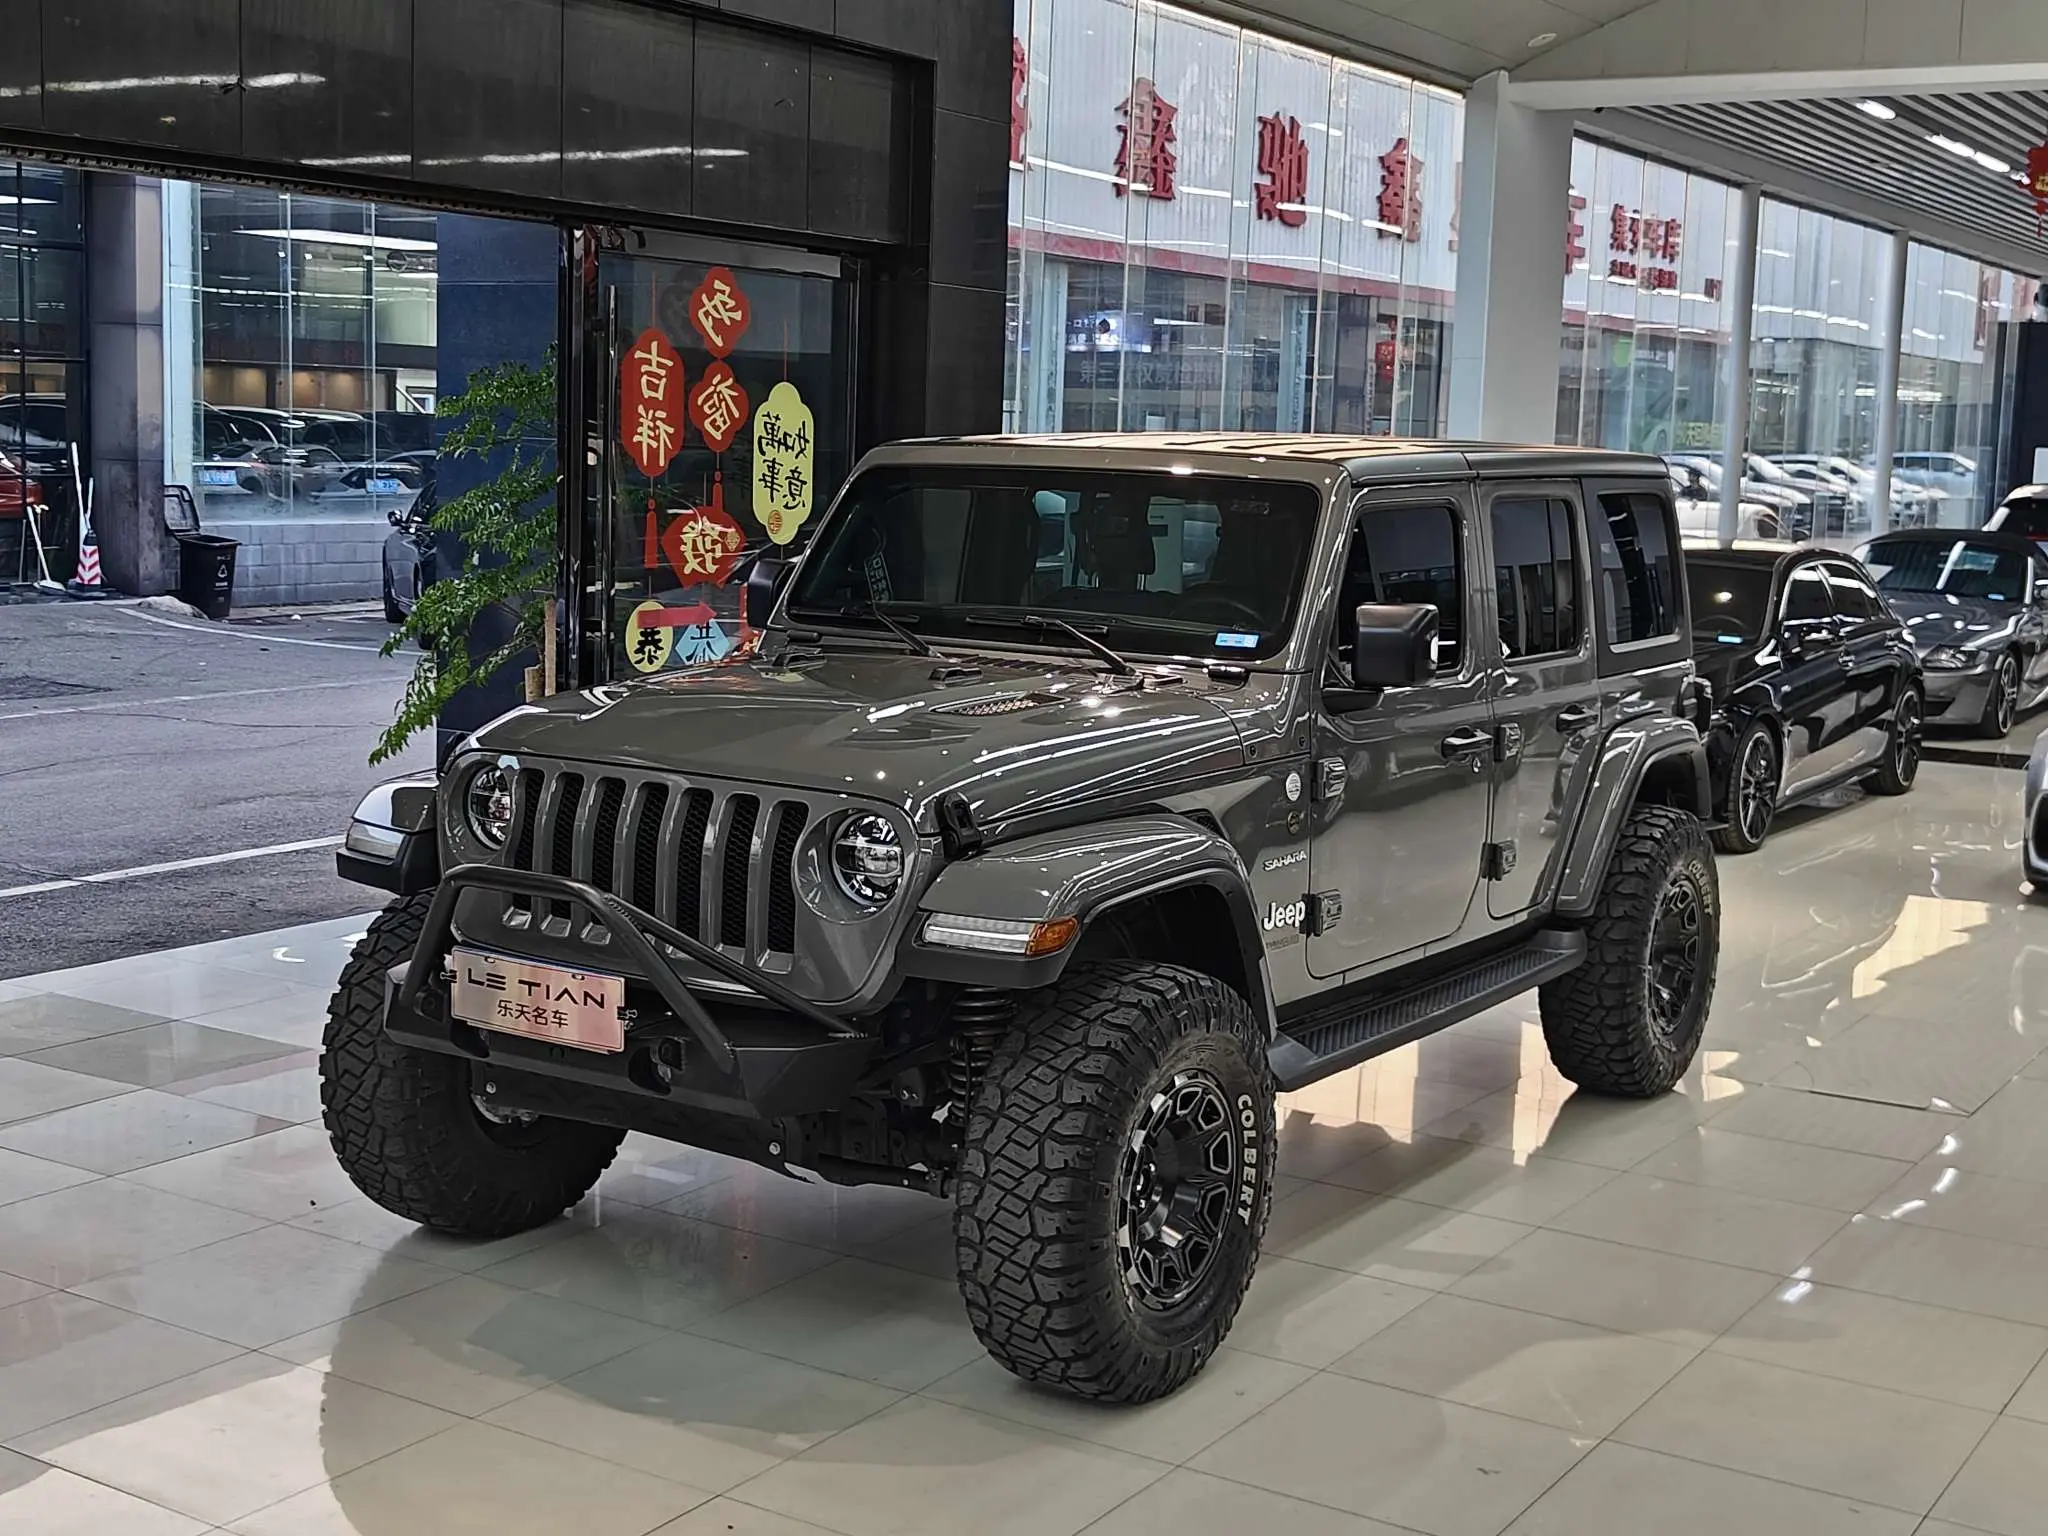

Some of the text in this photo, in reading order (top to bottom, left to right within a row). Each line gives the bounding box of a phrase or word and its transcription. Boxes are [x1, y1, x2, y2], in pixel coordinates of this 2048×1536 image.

[1264, 850, 1307, 871] SAHARA
[1263, 901, 1306, 931] Jeep
[468, 968, 605, 1009] LE TIAN
[497, 999, 569, 1029] 乐天名车
[1237, 1094, 1257, 1226] COLBERT
